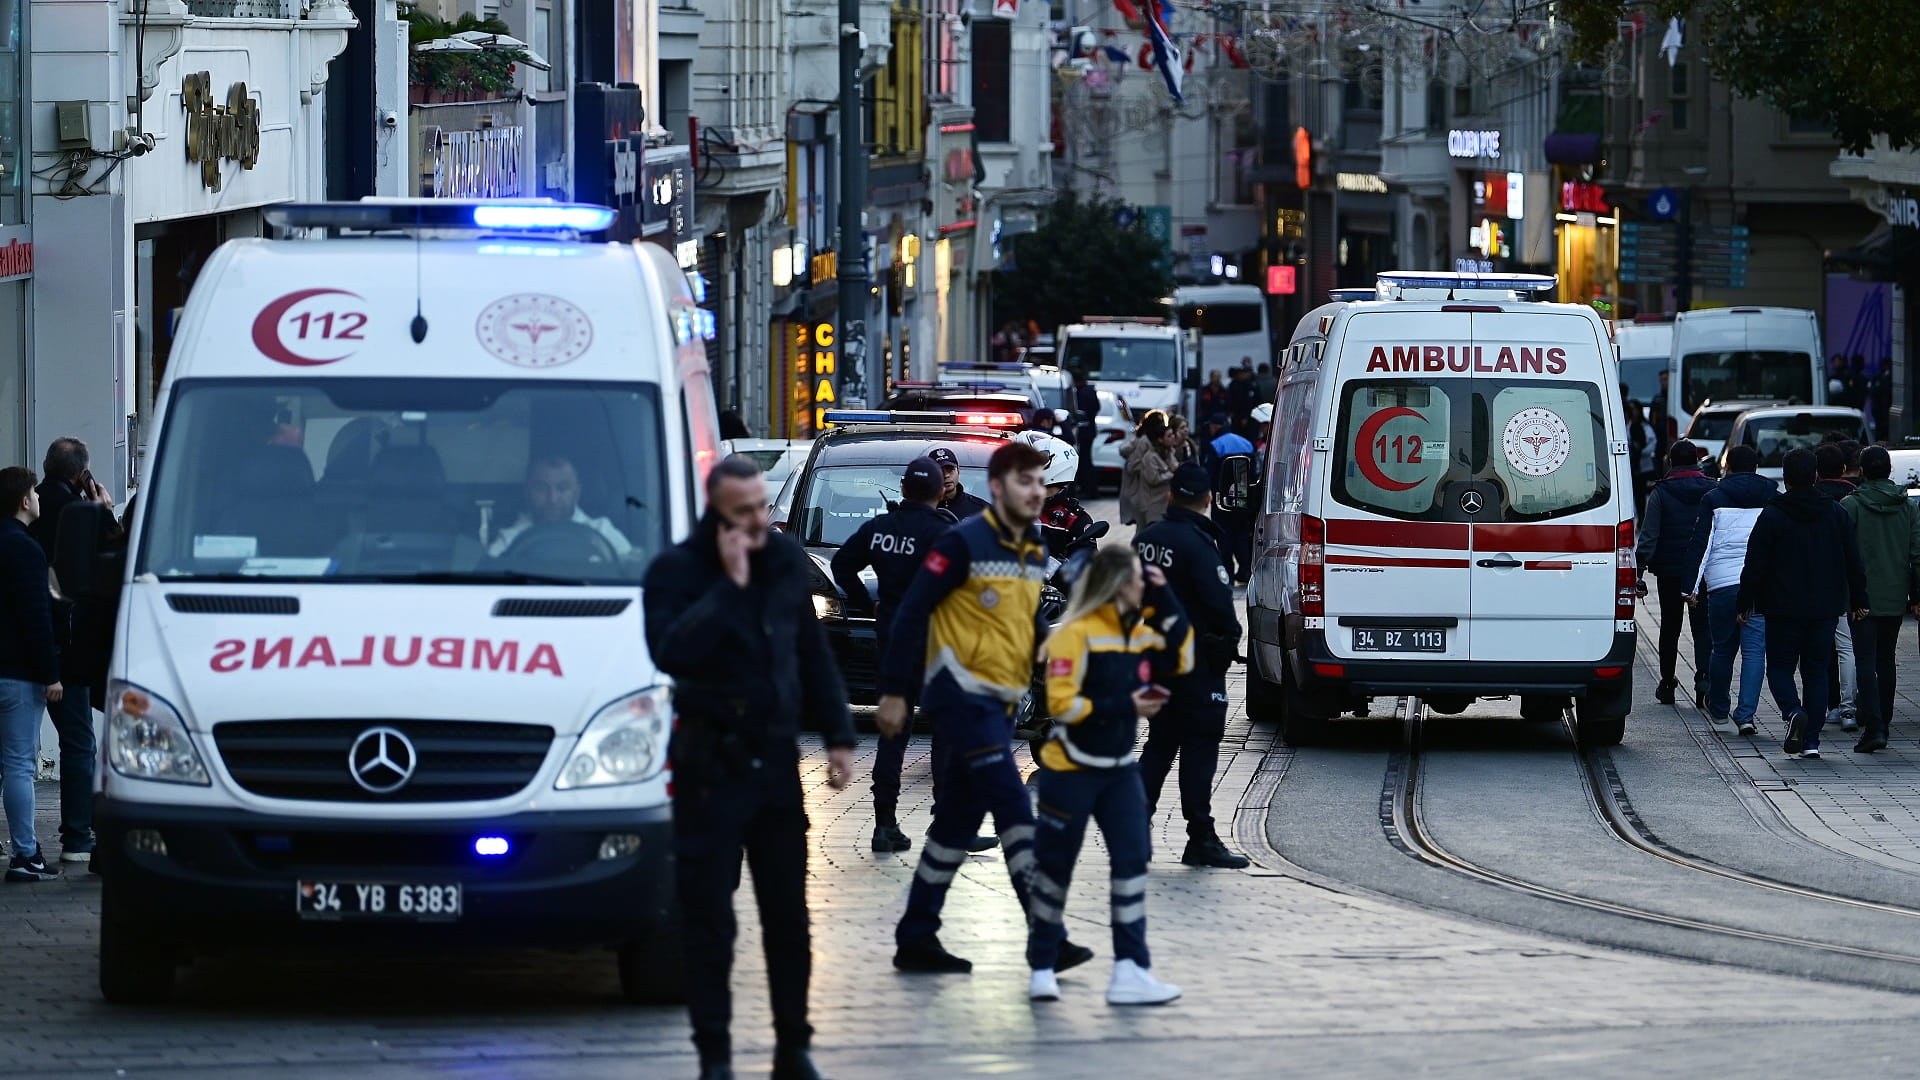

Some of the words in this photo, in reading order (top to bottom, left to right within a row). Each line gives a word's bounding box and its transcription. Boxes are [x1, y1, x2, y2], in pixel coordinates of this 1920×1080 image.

[290, 312, 368, 340] 112
[1366, 346, 1567, 374] AMBULANS
[1375, 435, 1422, 464] 112
[1358, 631, 1374, 646] 34
[1385, 631, 1402, 647] BZ
[1412, 631, 1441, 647] 1113
[313, 884, 341, 911] 34
[356, 885, 385, 912] YB
[400, 885, 457, 912] 6383
